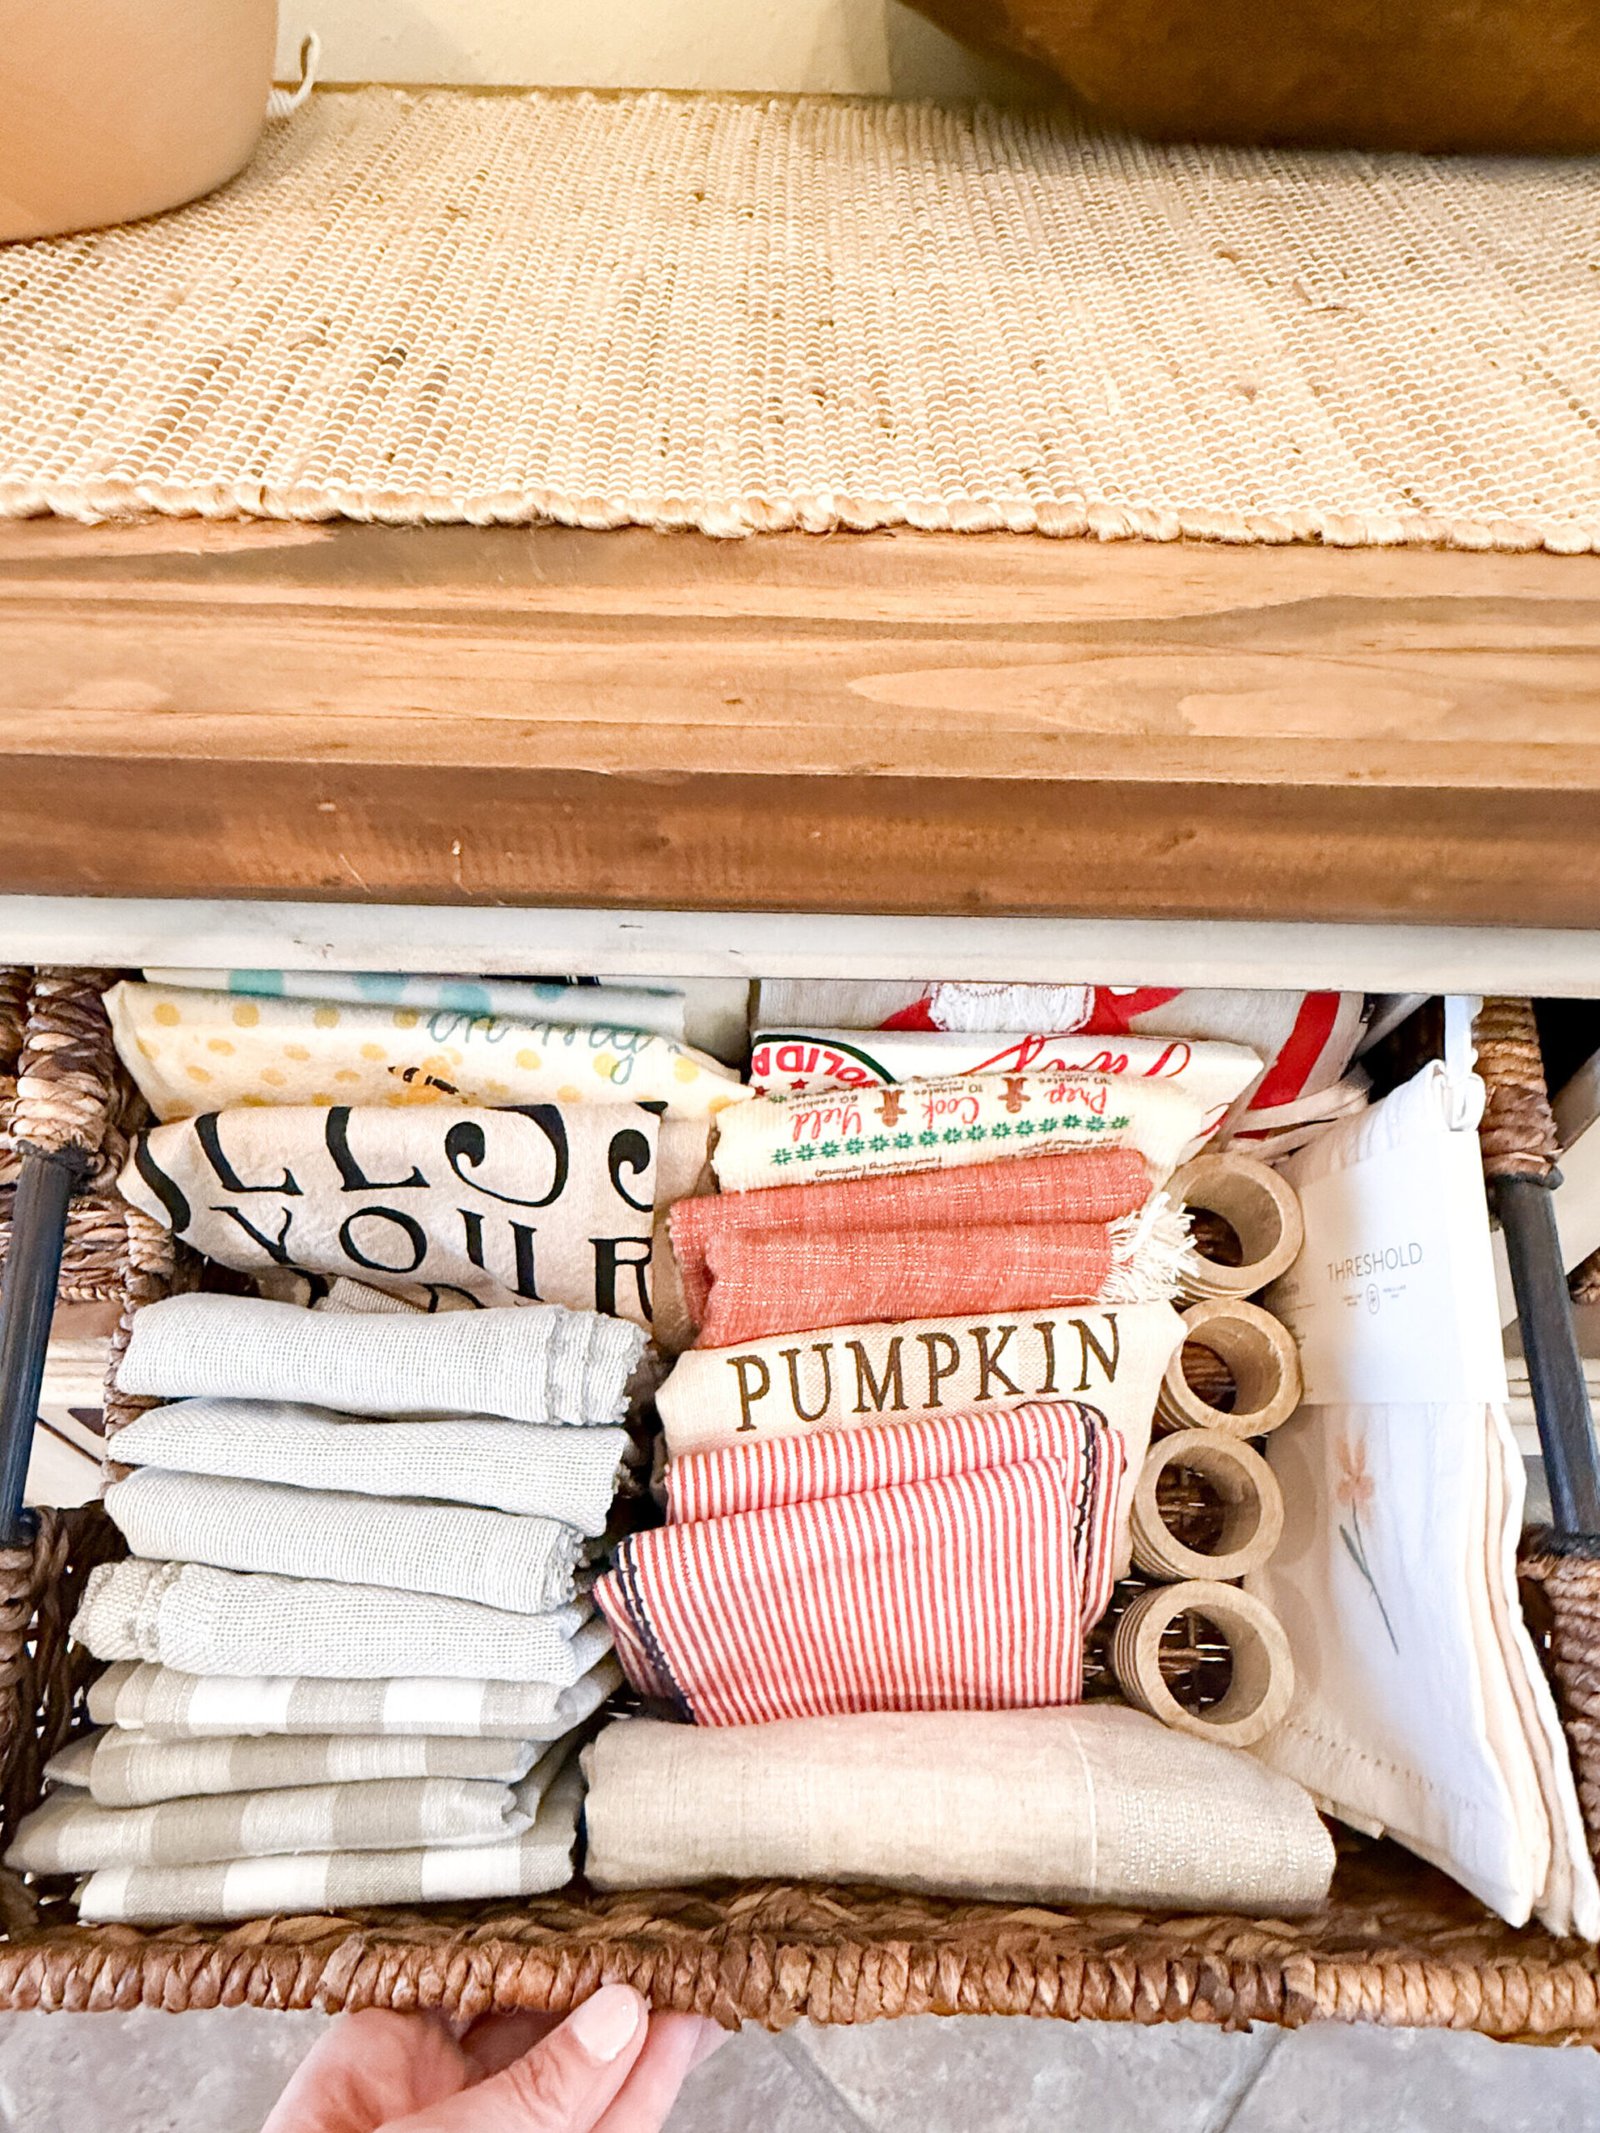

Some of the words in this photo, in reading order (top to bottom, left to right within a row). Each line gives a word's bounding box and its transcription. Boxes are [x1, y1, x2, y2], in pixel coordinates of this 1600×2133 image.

[922, 1095, 979, 1130] Cook
[1044, 1083, 1108, 1115] Prep
[788, 1104, 863, 1142] Yield
[1327, 1242, 1423, 1281] THRESHOLD
[727, 1313, 1120, 1432] PUMPKIN
